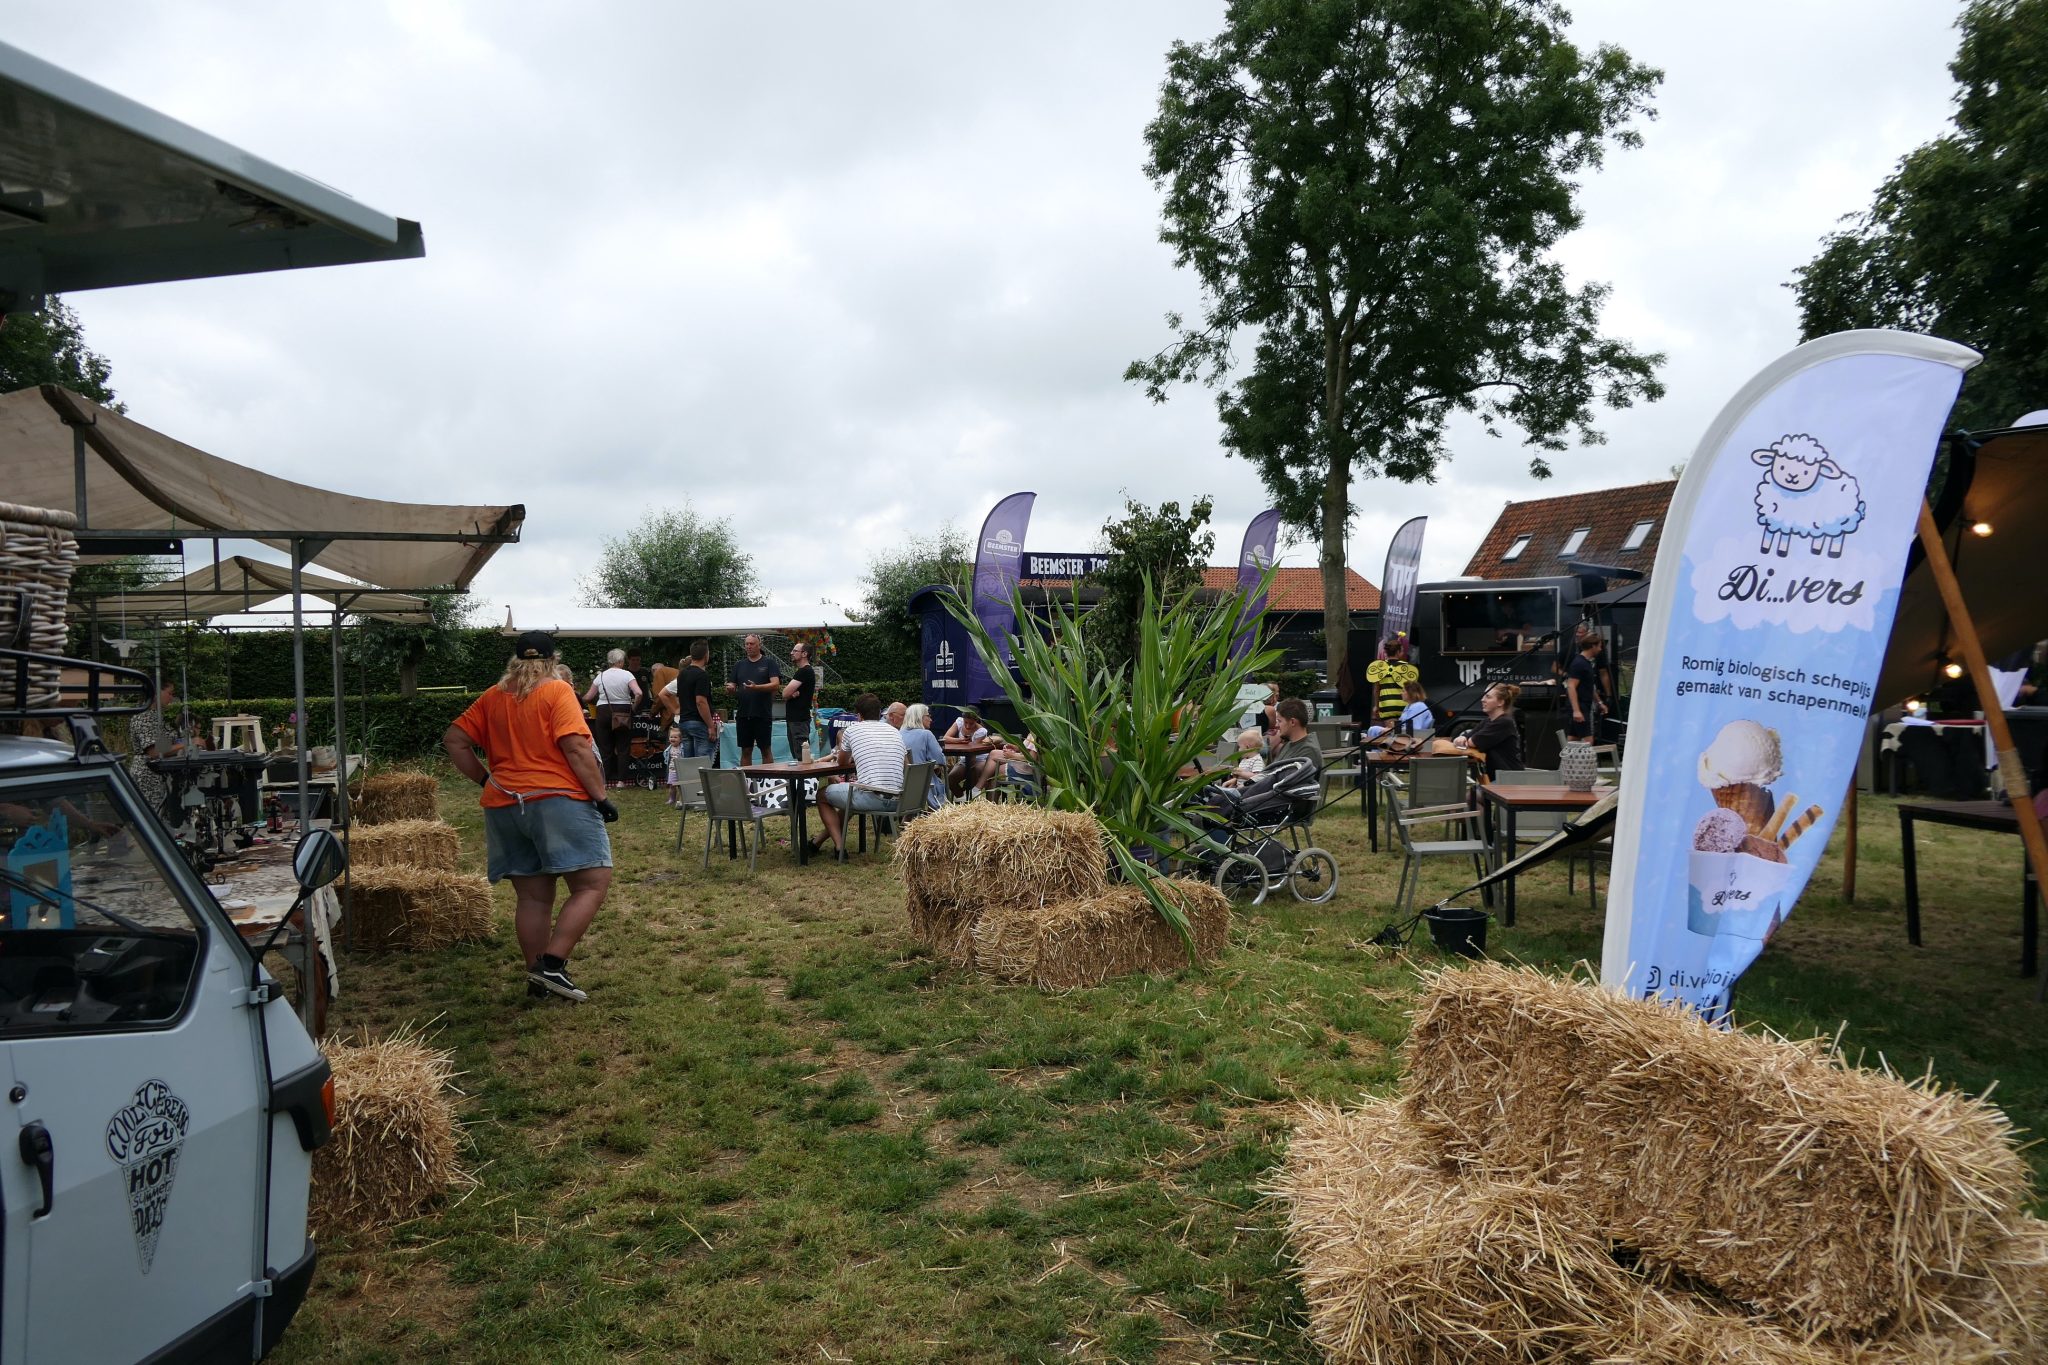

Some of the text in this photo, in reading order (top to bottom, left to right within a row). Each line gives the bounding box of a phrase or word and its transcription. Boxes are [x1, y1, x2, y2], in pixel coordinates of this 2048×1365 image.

[1030, 556, 1084, 576] BEEMSTER
[1717, 564, 1865, 605] Di...vers
[1681, 656, 1871, 700] Romig biologisch schepijs
[1676, 679, 1869, 721] gemaakt van schapenmelk
[108, 1082, 190, 1160] COOL ICE CREAM
[130, 1148, 176, 1194] HOT
[134, 1198, 167, 1237] DAYS
